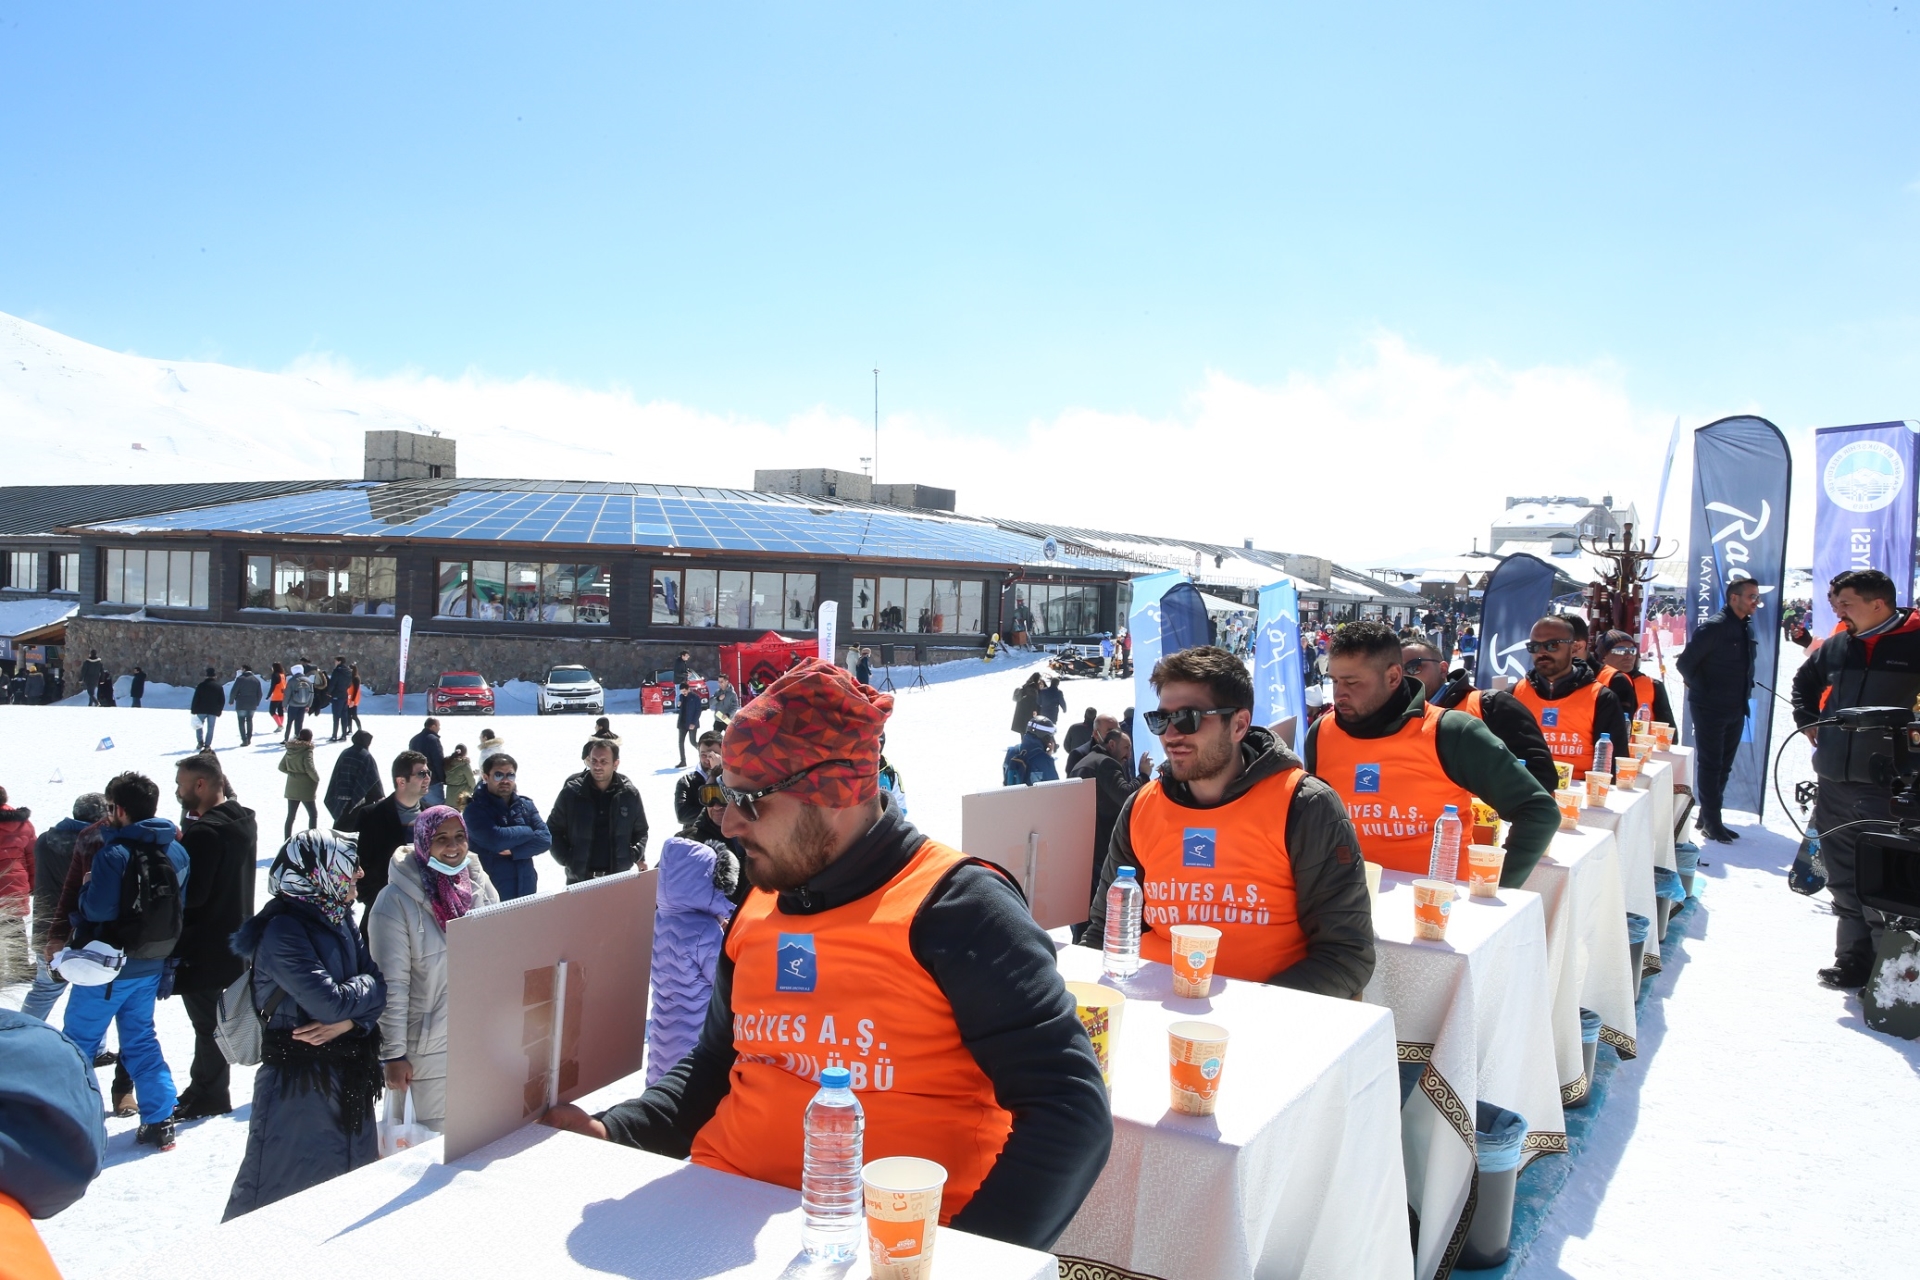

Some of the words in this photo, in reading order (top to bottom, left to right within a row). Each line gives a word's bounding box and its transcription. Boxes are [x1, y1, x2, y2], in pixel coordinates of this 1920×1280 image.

[1704, 499, 1775, 609] Rad
[1698, 555, 1713, 603] KAYAK
[1697, 605, 1710, 627] ME
[1543, 732, 1556, 742] ES
[1560, 732, 1582, 745] A.Ş.
[1347, 803, 1382, 819] İYES
[1389, 806, 1424, 822] A.Ş.
[1361, 821, 1429, 837] KULÜBÜ
[1144, 877, 1214, 901] ERCİYES
[1222, 883, 1266, 908] A.Ş.
[1145, 905, 1180, 924] SPOR
[1187, 903, 1270, 925] KULÜBÜ
[818, 1015, 887, 1056] A.Ş.
